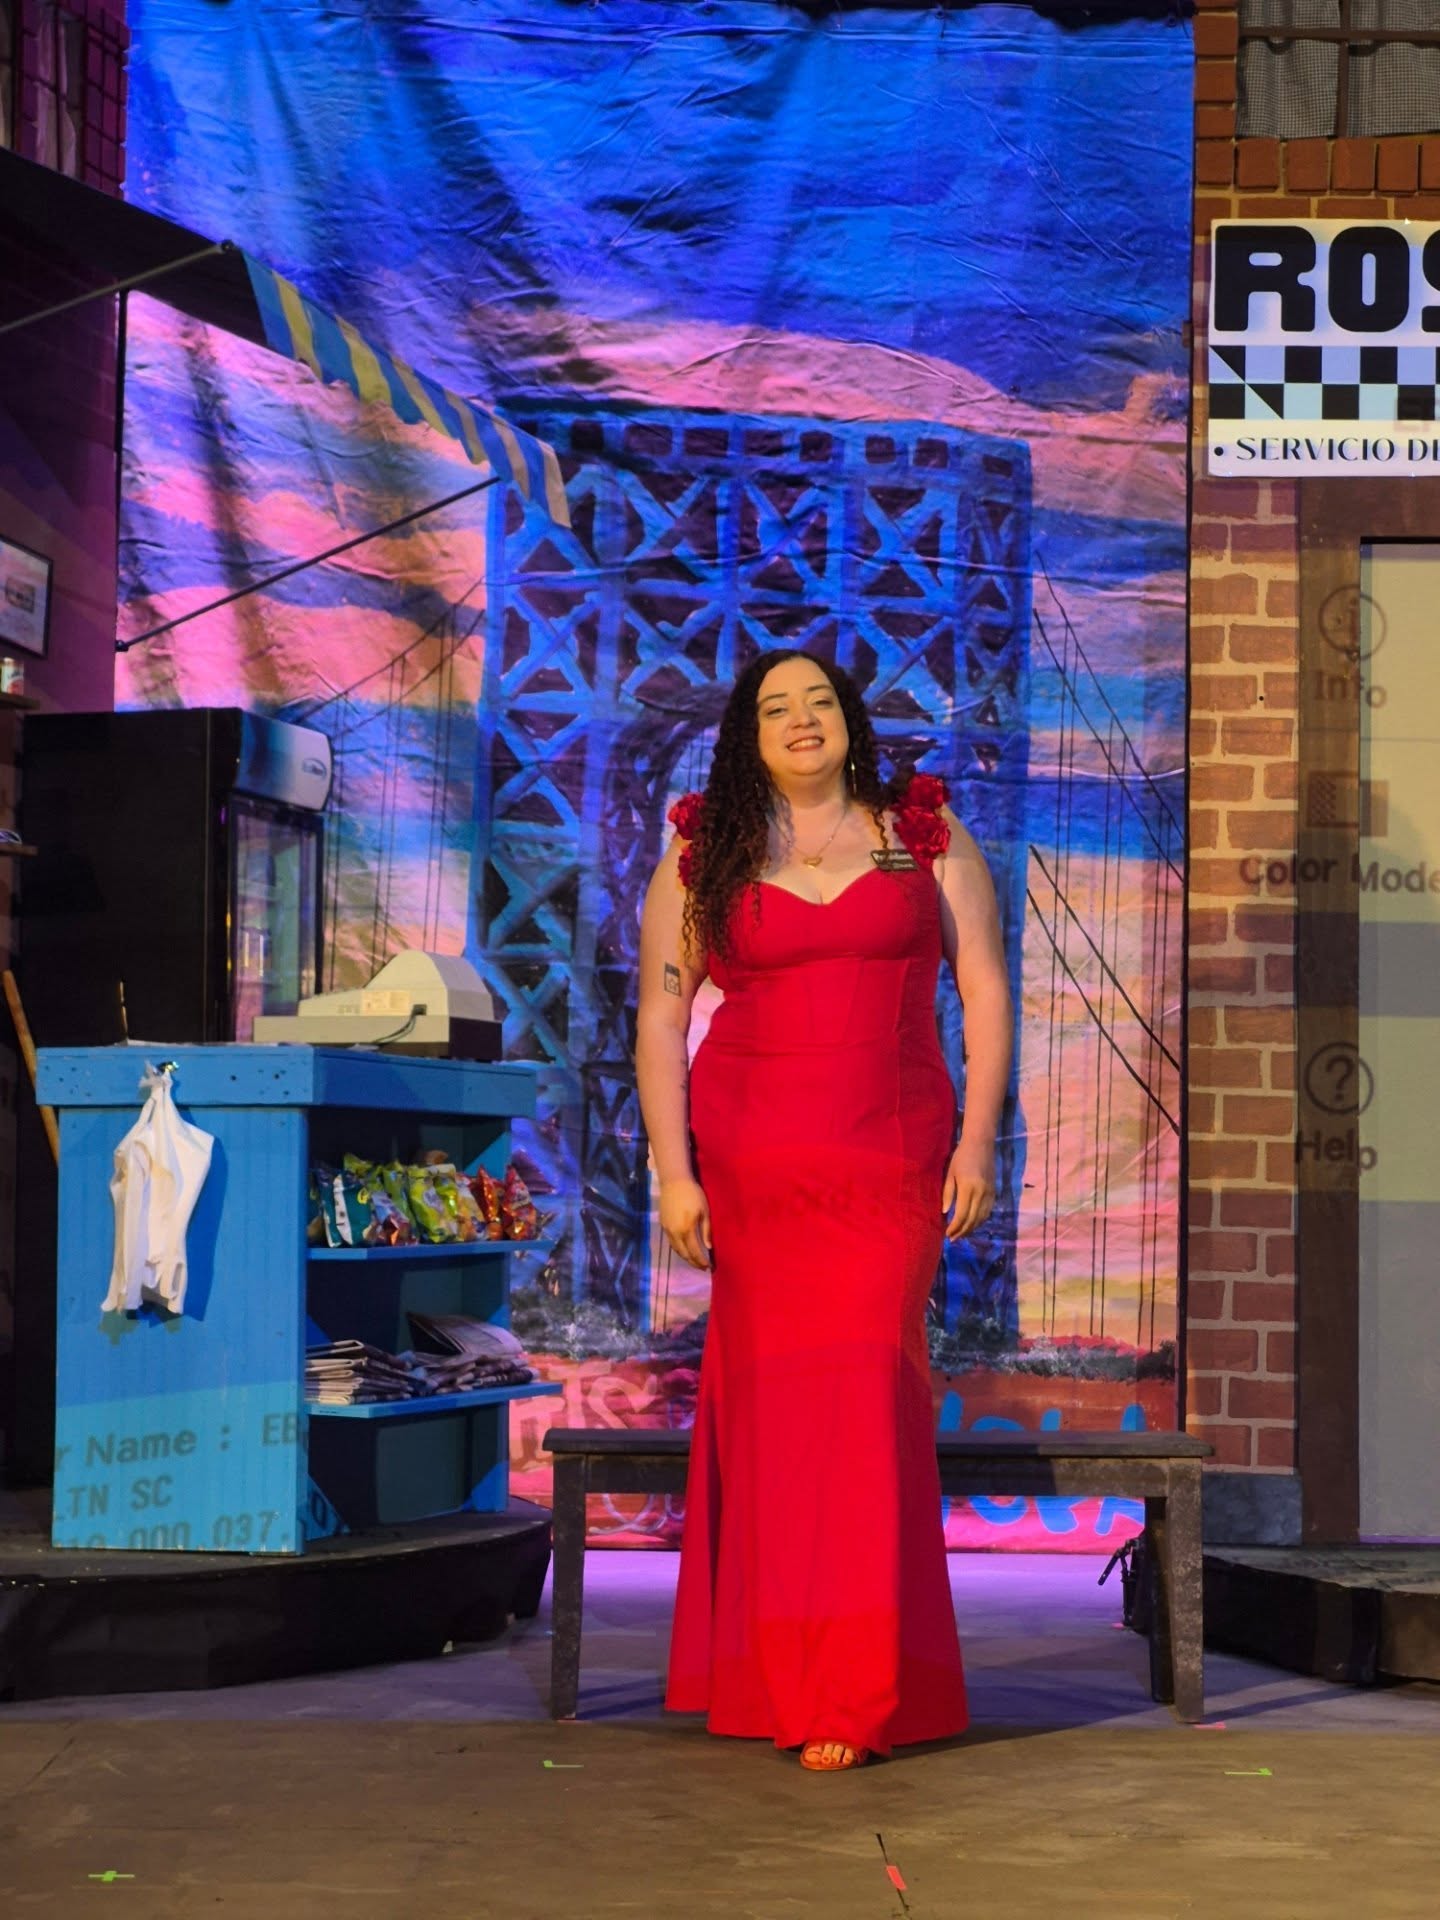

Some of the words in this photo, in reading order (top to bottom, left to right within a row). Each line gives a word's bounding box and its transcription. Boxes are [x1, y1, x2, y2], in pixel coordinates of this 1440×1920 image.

[1214, 225, 1440, 333] RO
[1236, 437, 1395, 461] SERVICIO
[1238, 853, 1339, 886] Color
[1295, 1128, 1378, 1176] Help
[84, 1428, 198, 1467] Name
[131, 1474, 174, 1512] SC
